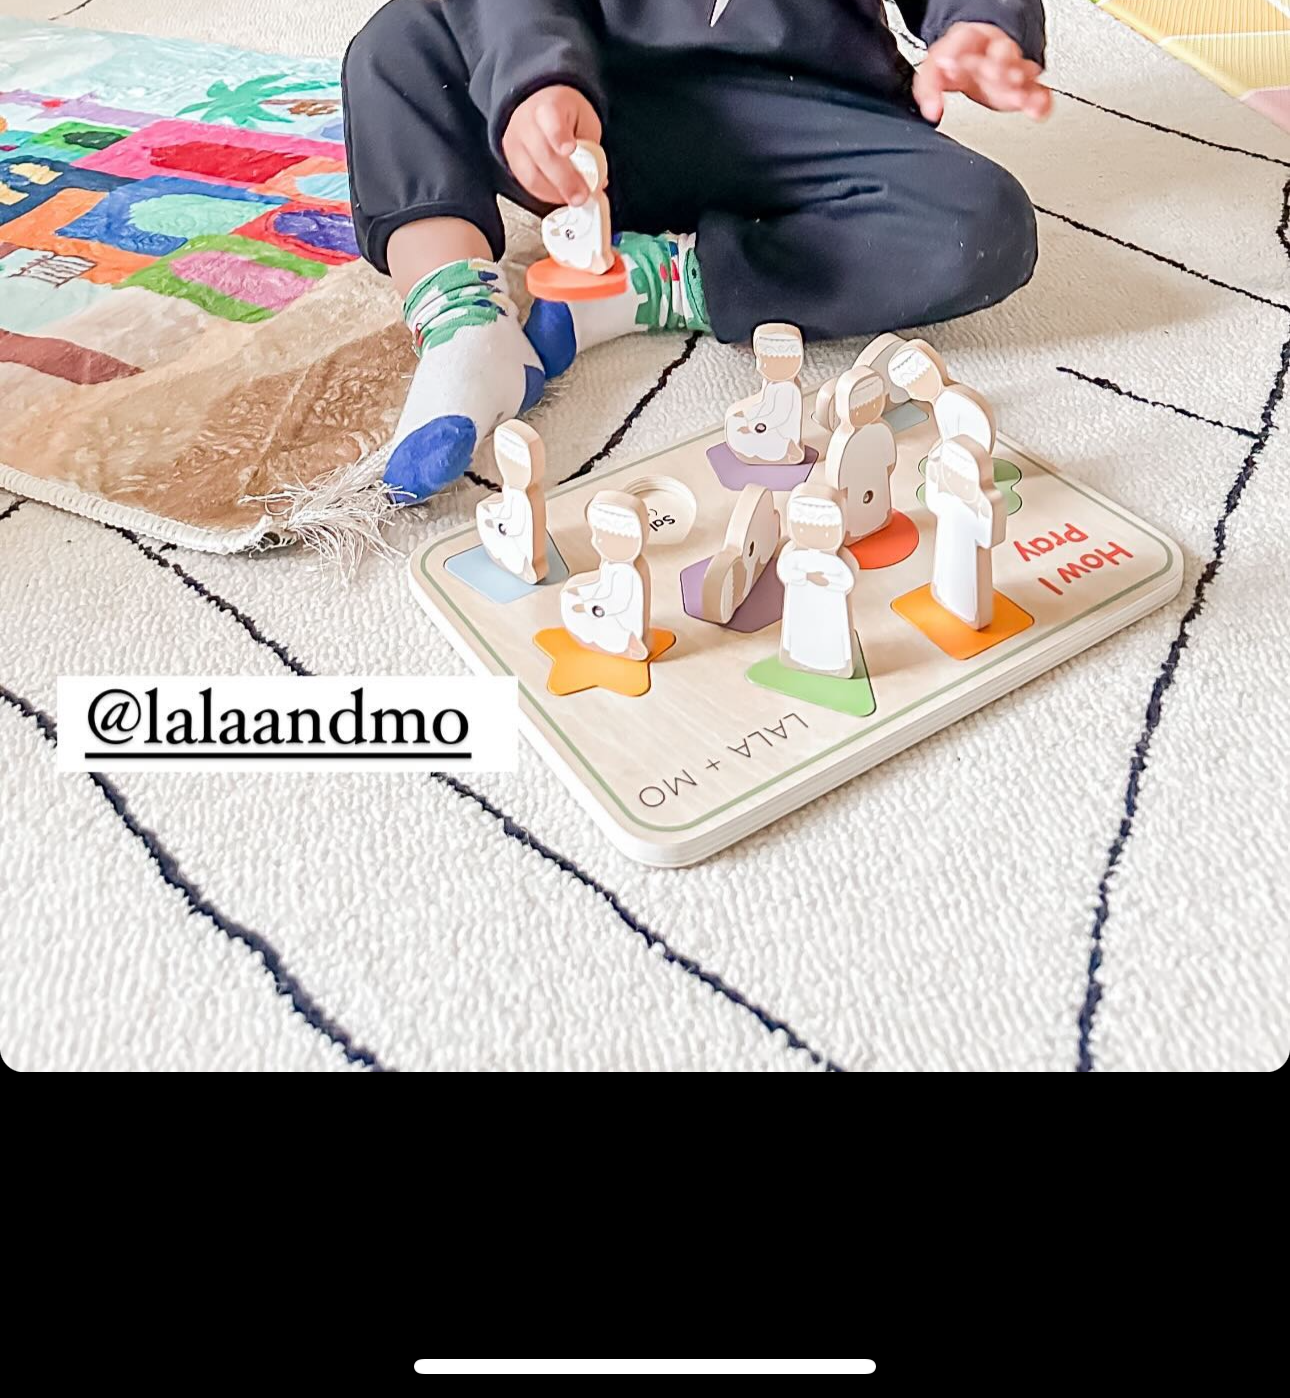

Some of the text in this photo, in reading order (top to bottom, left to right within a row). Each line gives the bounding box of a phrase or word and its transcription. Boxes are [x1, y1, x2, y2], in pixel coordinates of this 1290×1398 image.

[649, 514, 676, 532] Sal
[1013, 522, 1089, 562] Pray
[1037, 541, 1134, 596] How I
[726, 712, 809, 758] LALA
[639, 768, 698, 808] MO
